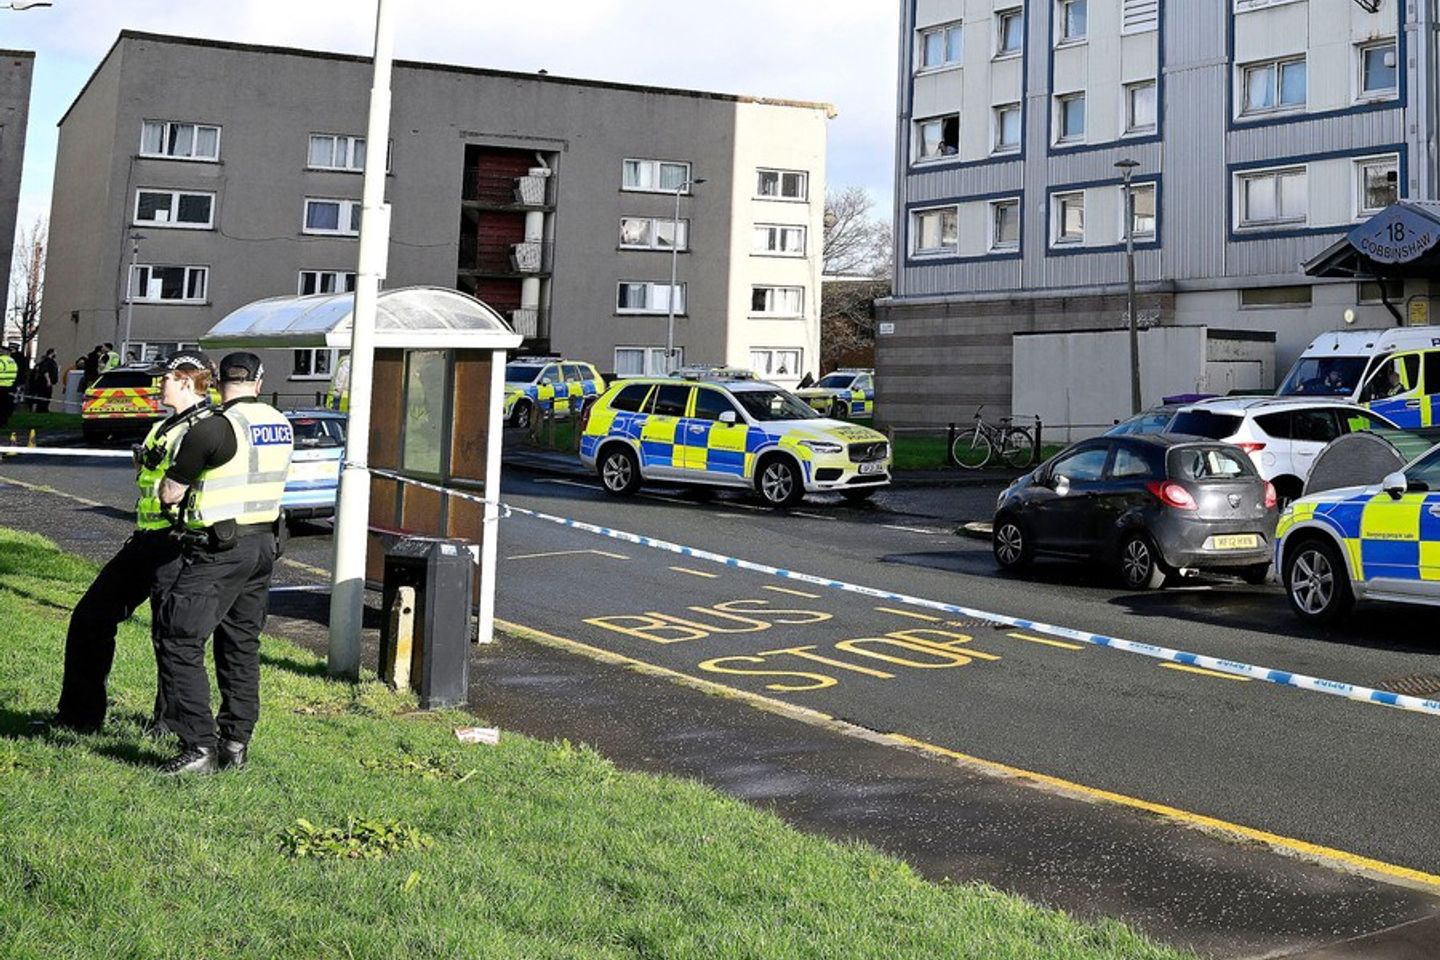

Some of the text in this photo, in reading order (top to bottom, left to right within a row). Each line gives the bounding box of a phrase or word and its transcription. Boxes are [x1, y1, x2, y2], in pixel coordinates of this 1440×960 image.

[1361, 232, 1431, 259] COBBINSHAW
[1386, 222, 1405, 242] 18
[252, 426, 292, 443] POLICE
[582, 600, 833, 644] BUS
[698, 629, 1001, 692] STOP
